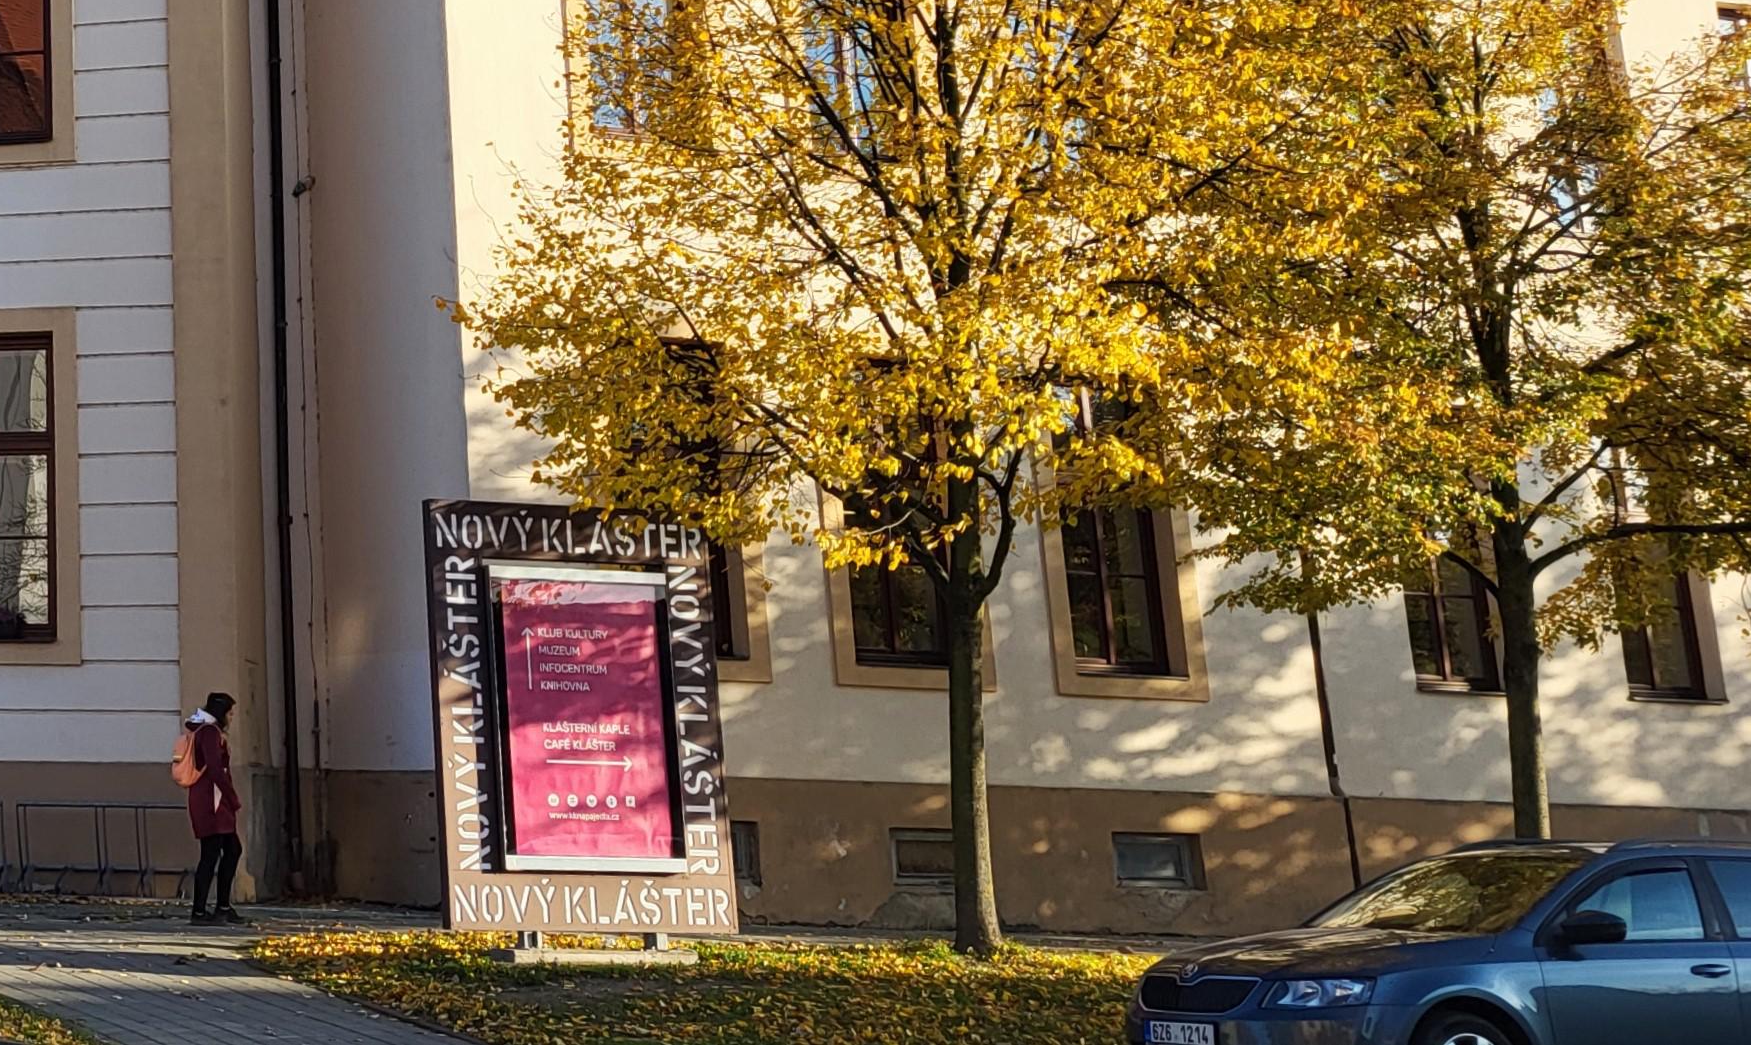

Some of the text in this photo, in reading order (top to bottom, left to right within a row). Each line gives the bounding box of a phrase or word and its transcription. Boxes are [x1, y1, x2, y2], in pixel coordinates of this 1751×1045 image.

[435, 510, 701, 560] NOVÝ KLÁŠTER
[537, 628, 608, 640] KLUB KULTURY
[538, 645, 580, 656] MUZEUM
[539, 663, 608, 675] INFOCENTRUM
[540, 680, 591, 692] KNIHOVNA
[443, 556, 491, 871] NOVÝ KLÁŠTER
[667, 564, 723, 875] NOVÝ KLÁŠTER
[542, 721, 631, 735] KLÁŠTERNÍ KAPLE
[544, 738, 617, 752] CAFÉ KLÁŠTER
[454, 879, 731, 928] NOVÝ KLÁŠTER
[1152, 1023, 1209, 1044] 6Z6 1214
